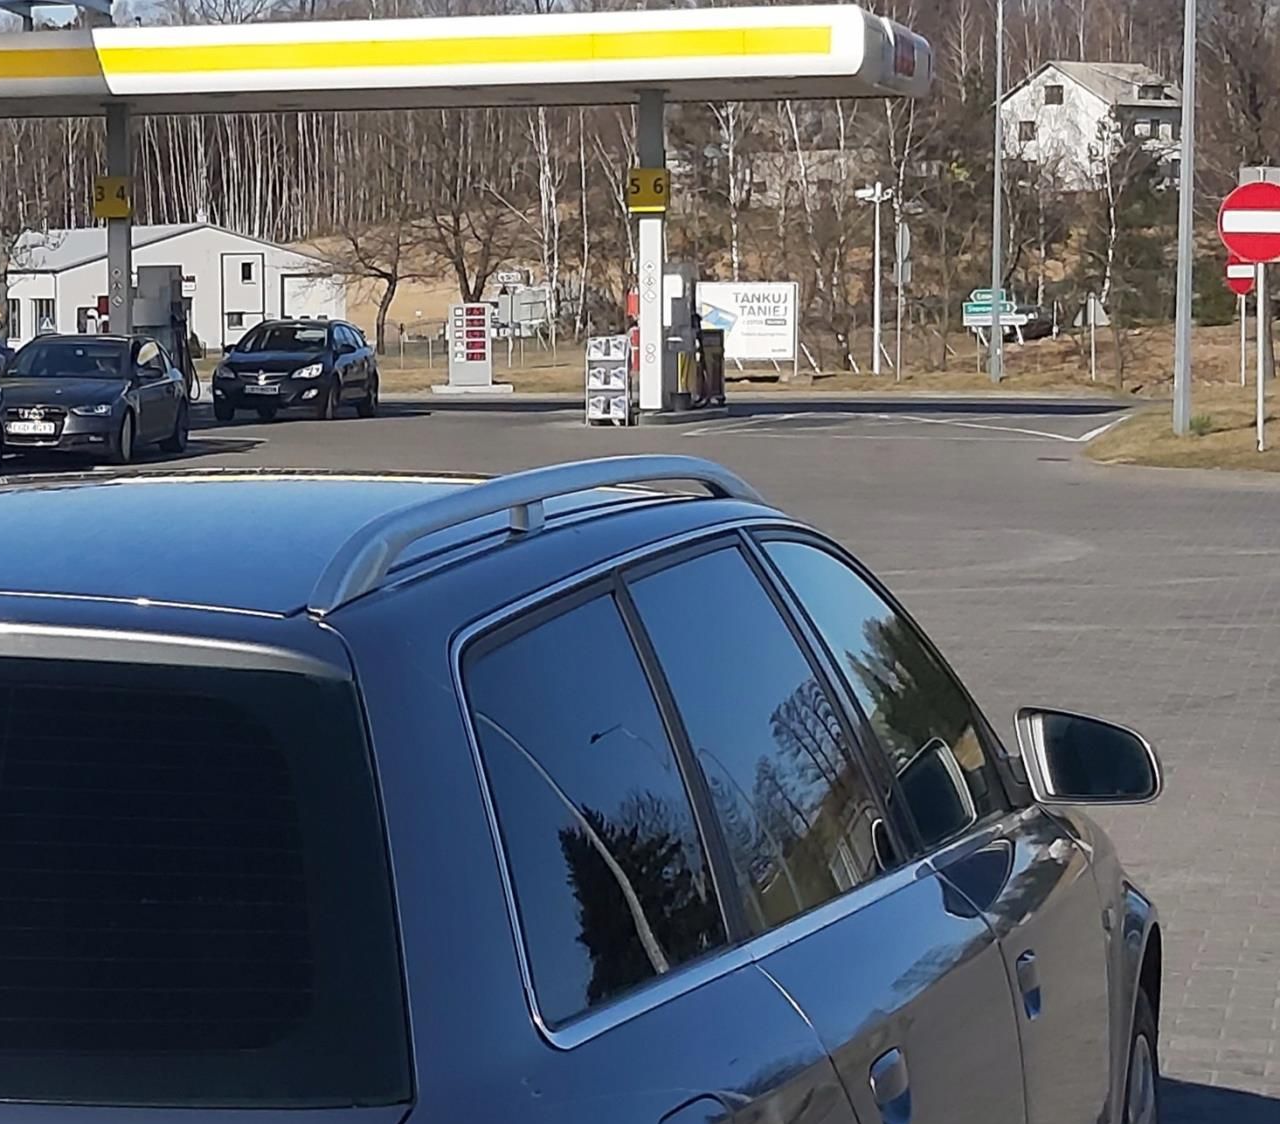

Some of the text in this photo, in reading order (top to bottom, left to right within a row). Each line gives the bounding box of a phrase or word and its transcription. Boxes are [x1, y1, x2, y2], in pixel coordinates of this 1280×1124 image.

[630, 177, 663, 195] 5 6
[95, 185, 125, 202] 3 4
[732, 292, 788, 304] TANKUJ
[739, 305, 788, 317] TANIEJ
